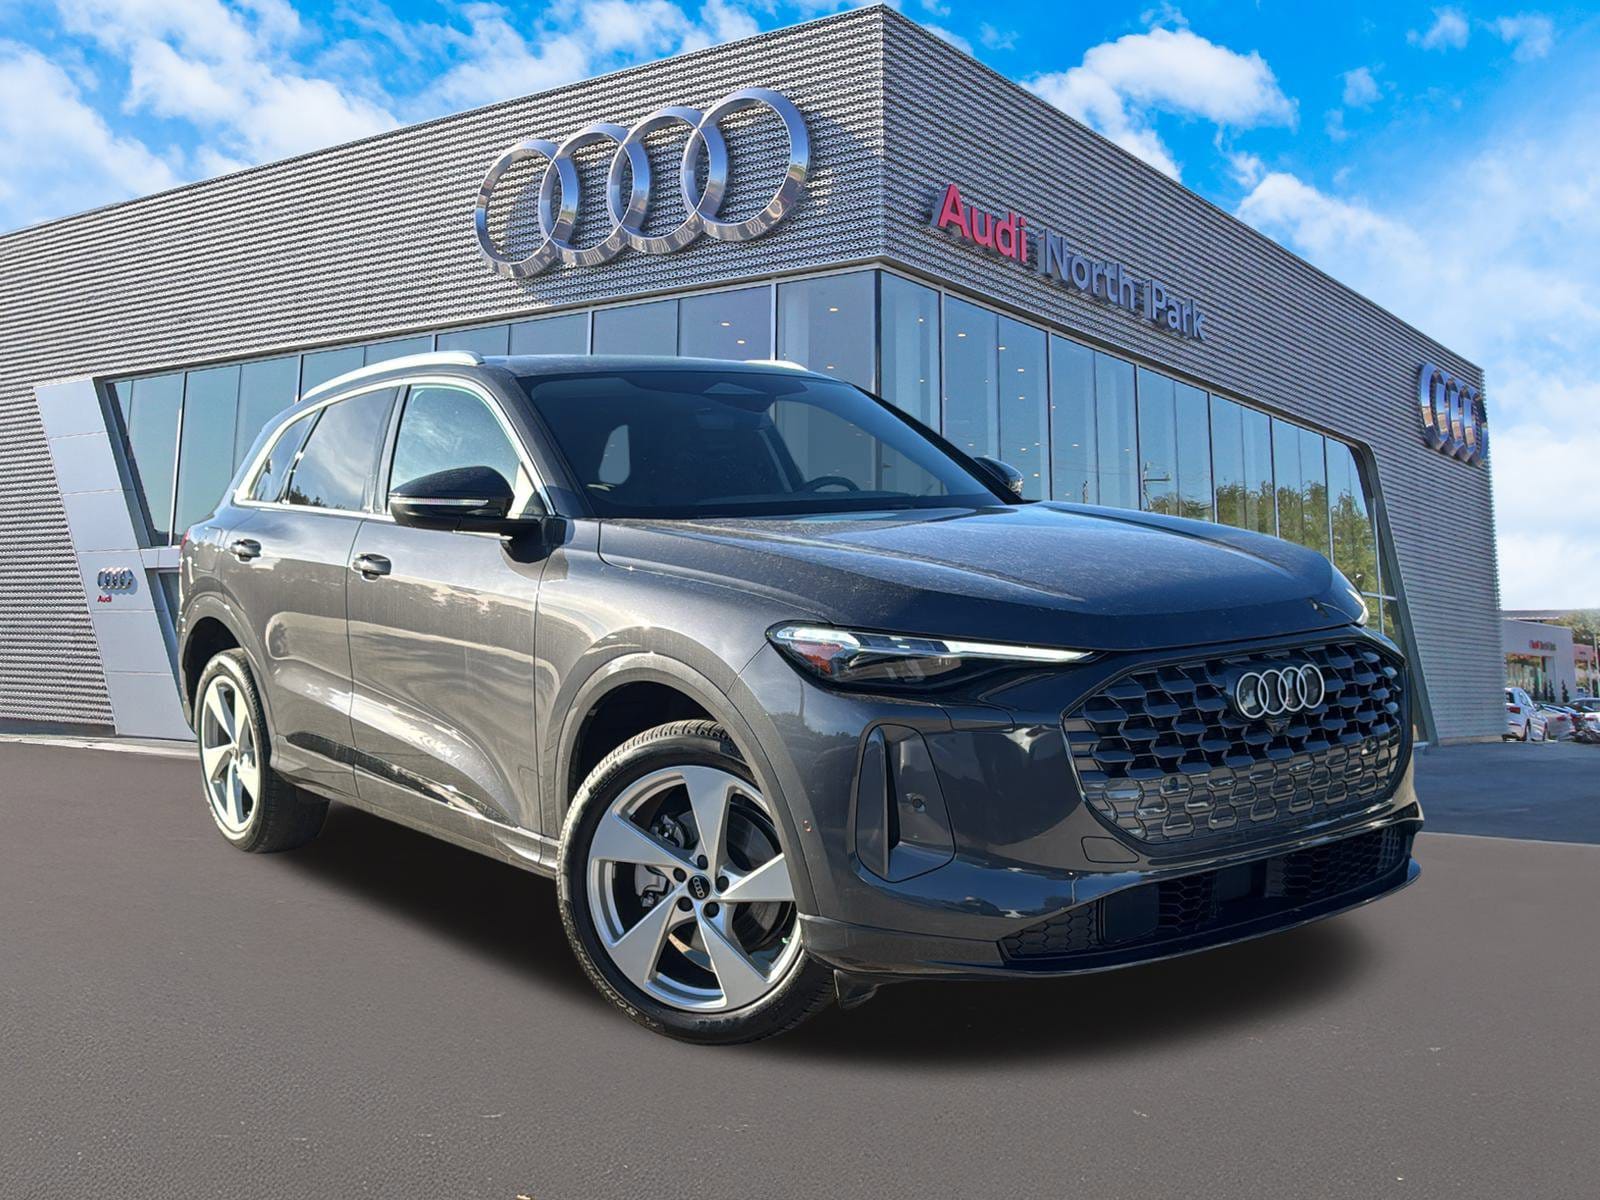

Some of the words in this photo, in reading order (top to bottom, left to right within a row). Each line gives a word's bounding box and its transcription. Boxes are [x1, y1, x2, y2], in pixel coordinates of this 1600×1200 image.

[935, 183, 1028, 264] Audi
[1040, 229, 1137, 310] North
[1145, 278, 1207, 342] Park
